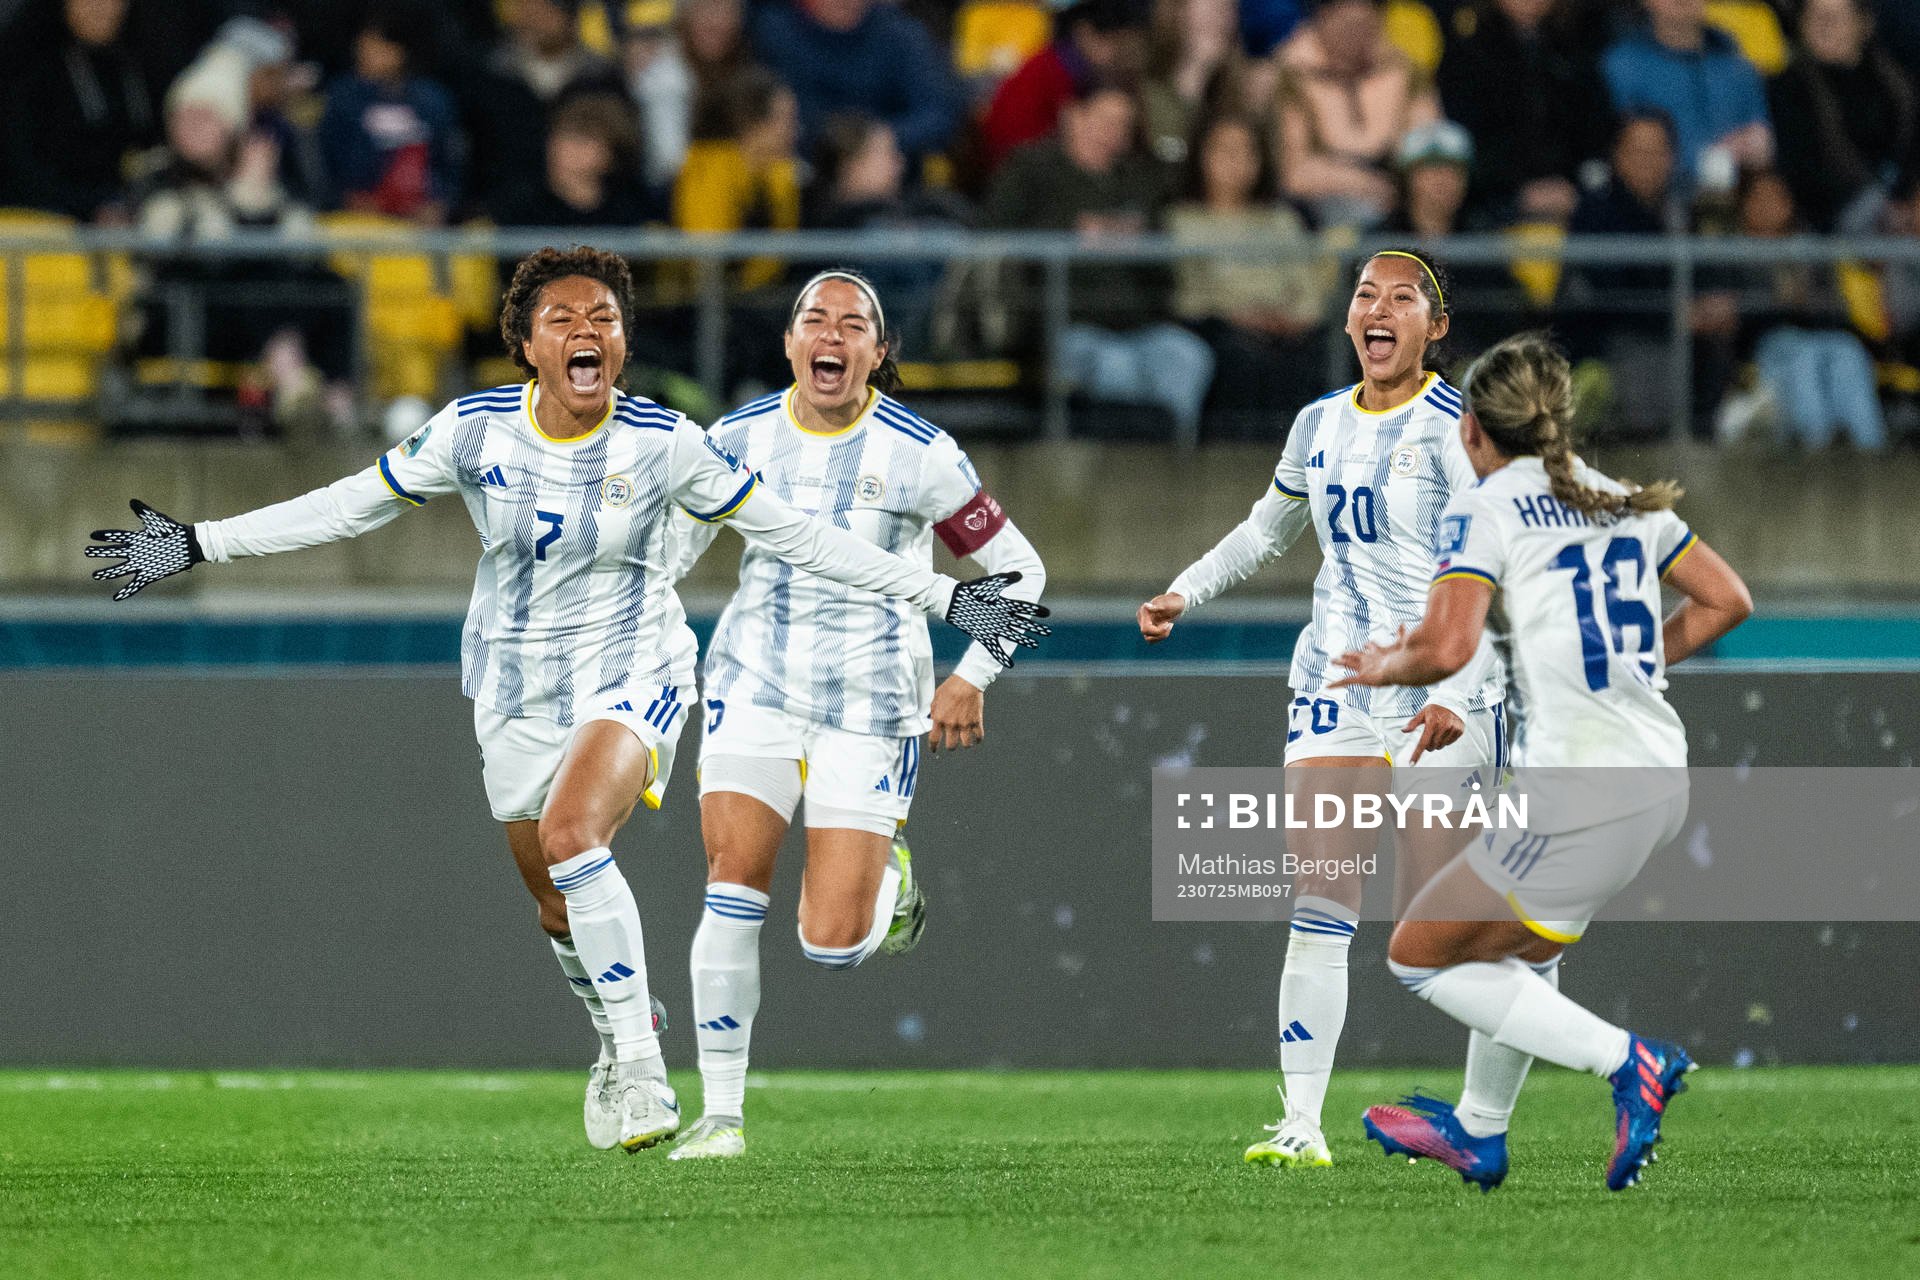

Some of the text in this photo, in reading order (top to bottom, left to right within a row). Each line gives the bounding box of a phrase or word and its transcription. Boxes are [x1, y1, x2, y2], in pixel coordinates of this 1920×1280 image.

[610, 491, 625, 500] PFF
[1326, 485, 1378, 543] 20
[535, 510, 564, 562] 7
[1547, 537, 1656, 692] 16
